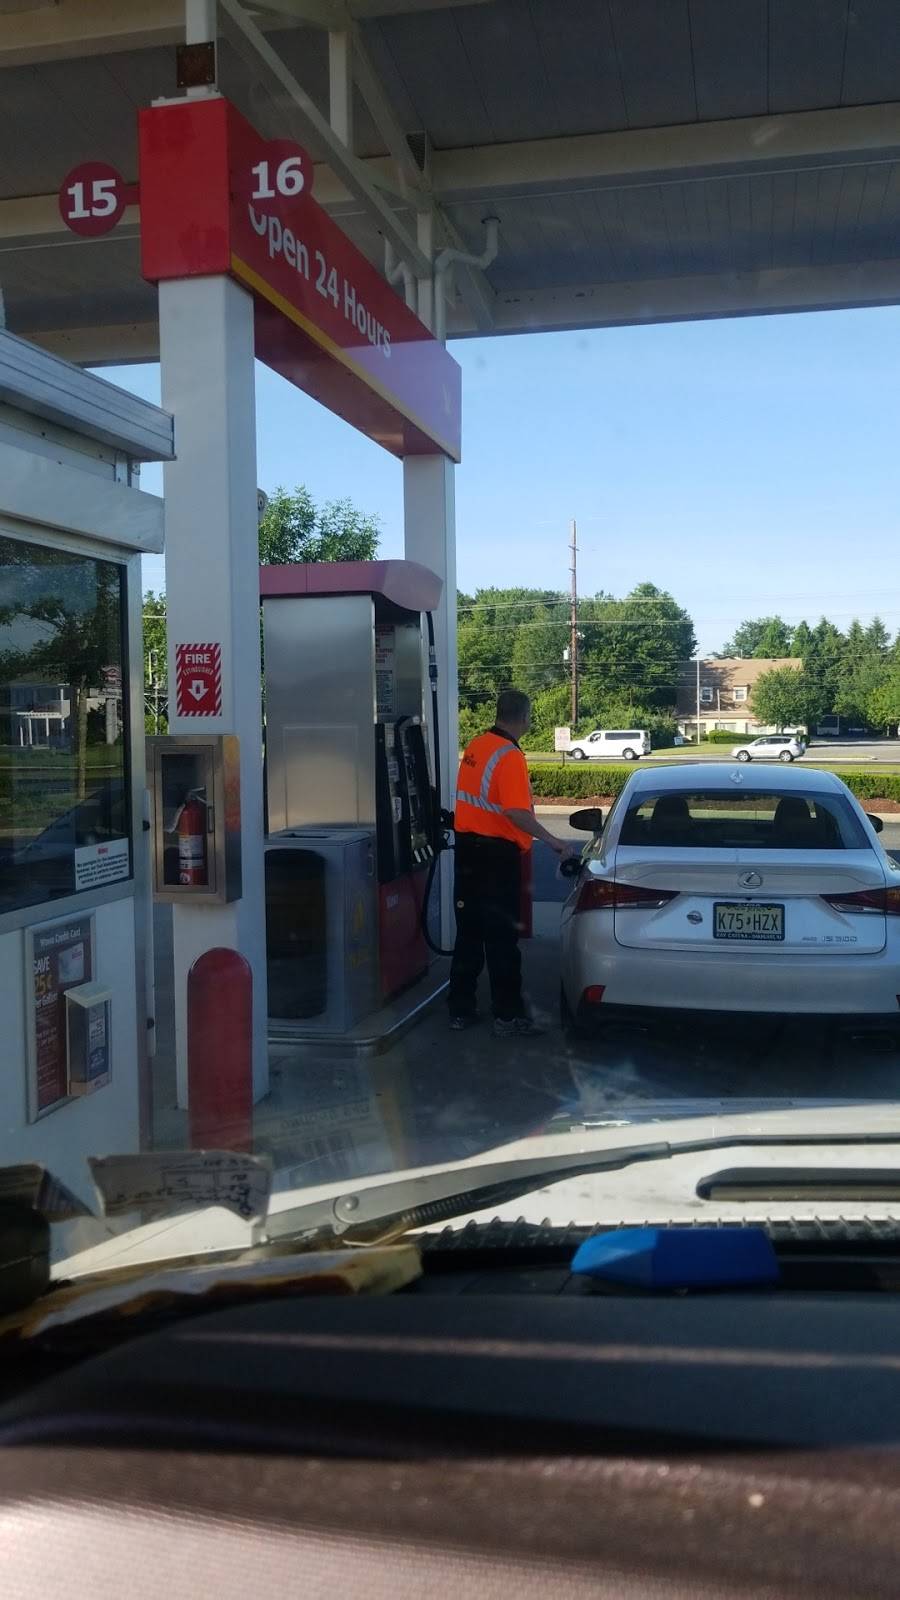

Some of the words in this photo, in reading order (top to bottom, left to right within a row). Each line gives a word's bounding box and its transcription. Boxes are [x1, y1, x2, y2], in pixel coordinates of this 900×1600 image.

[252, 156, 305, 199] 16
[67, 178, 118, 219] 15
[315, 250, 340, 308] 24
[344, 279, 392, 359] Hours
[185, 653, 212, 664] FIRE
[718, 912, 744, 930] K75
[753, 913, 778, 931] HZX
